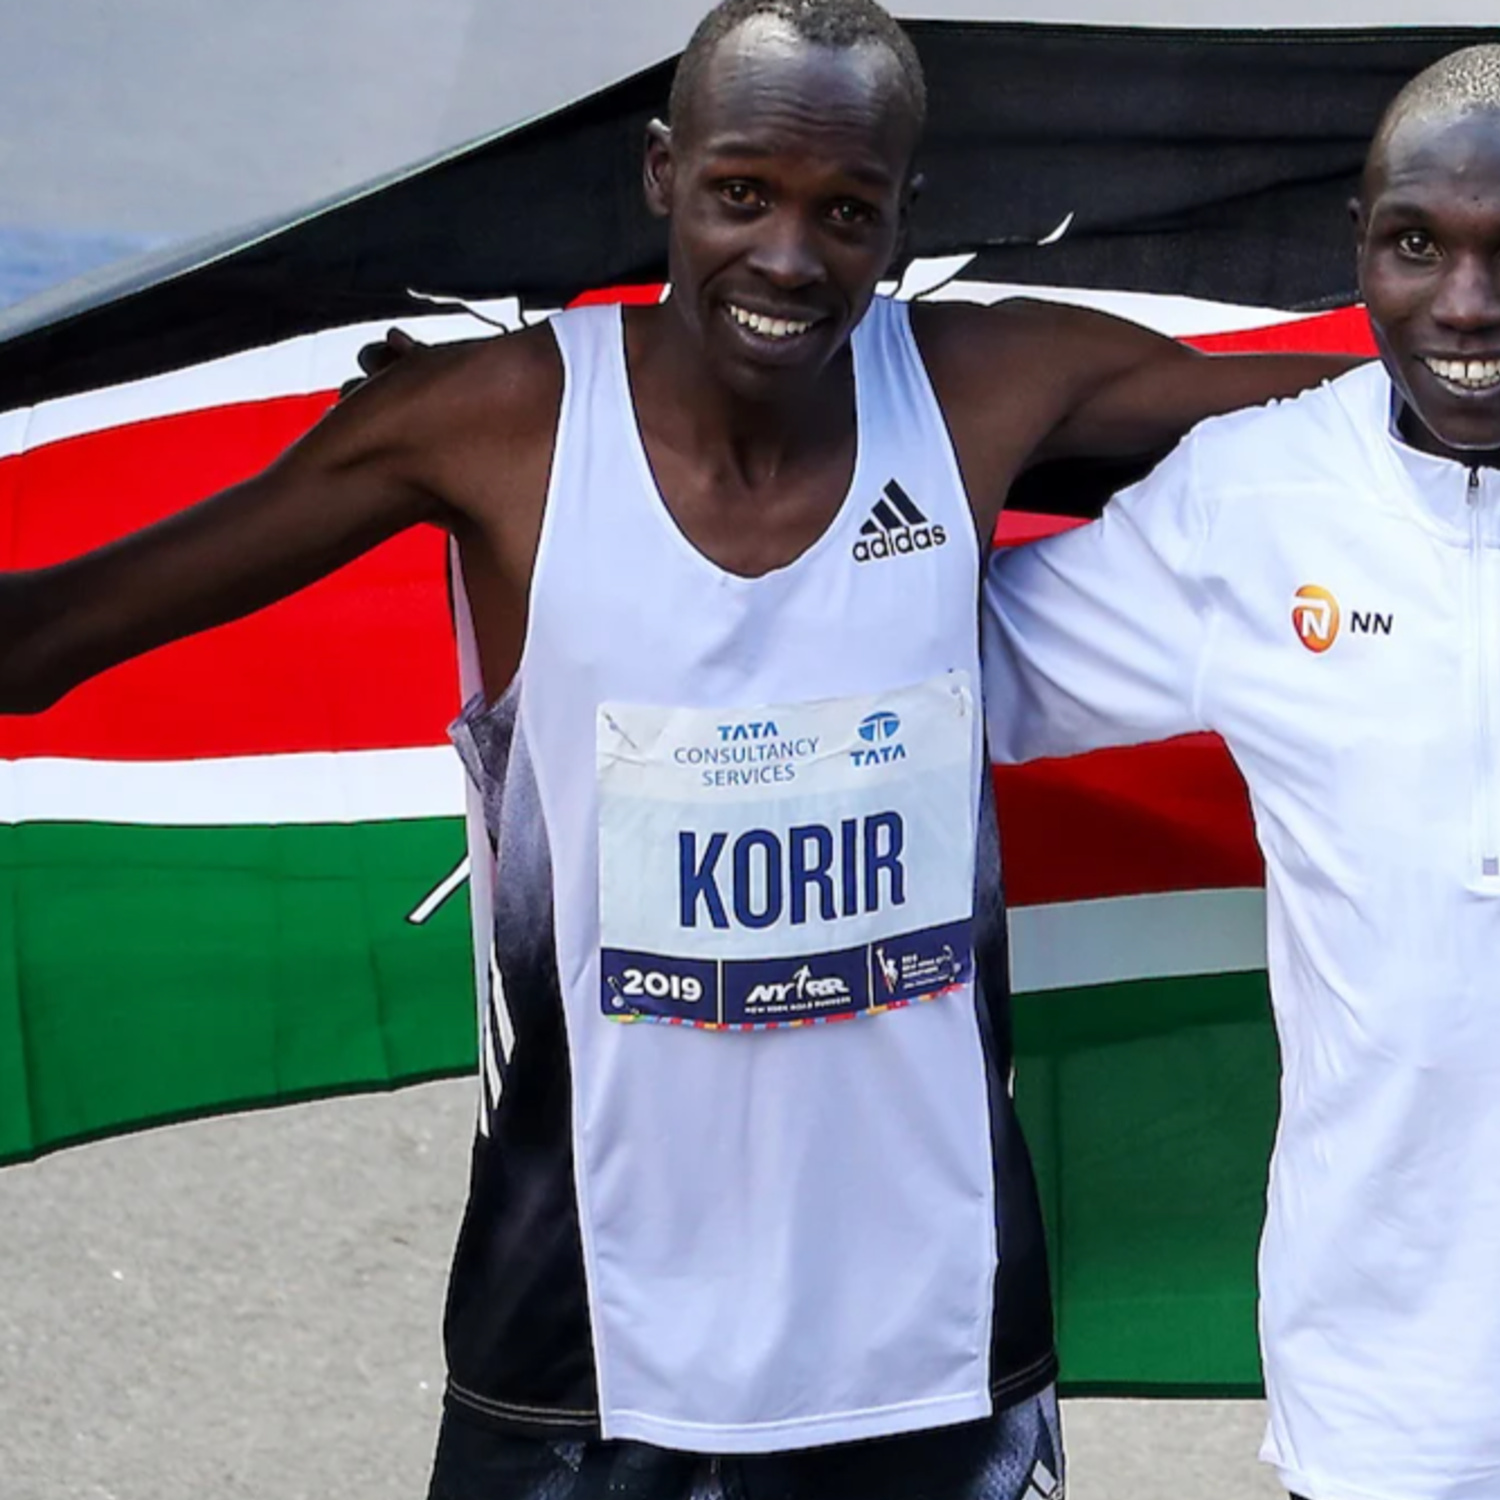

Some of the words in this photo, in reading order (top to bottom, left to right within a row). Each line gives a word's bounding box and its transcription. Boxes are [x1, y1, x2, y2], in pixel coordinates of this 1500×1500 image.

[852, 524, 946, 563] adidas
[1350, 610, 1393, 635] NN
[717, 721, 778, 741] TATA
[674, 736, 820, 765] CONSULTANCY
[850, 743, 906, 767] TATA
[702, 763, 796, 787] SERVICES
[678, 810, 906, 930] KORIR
[622, 968, 703, 1002] 2019
